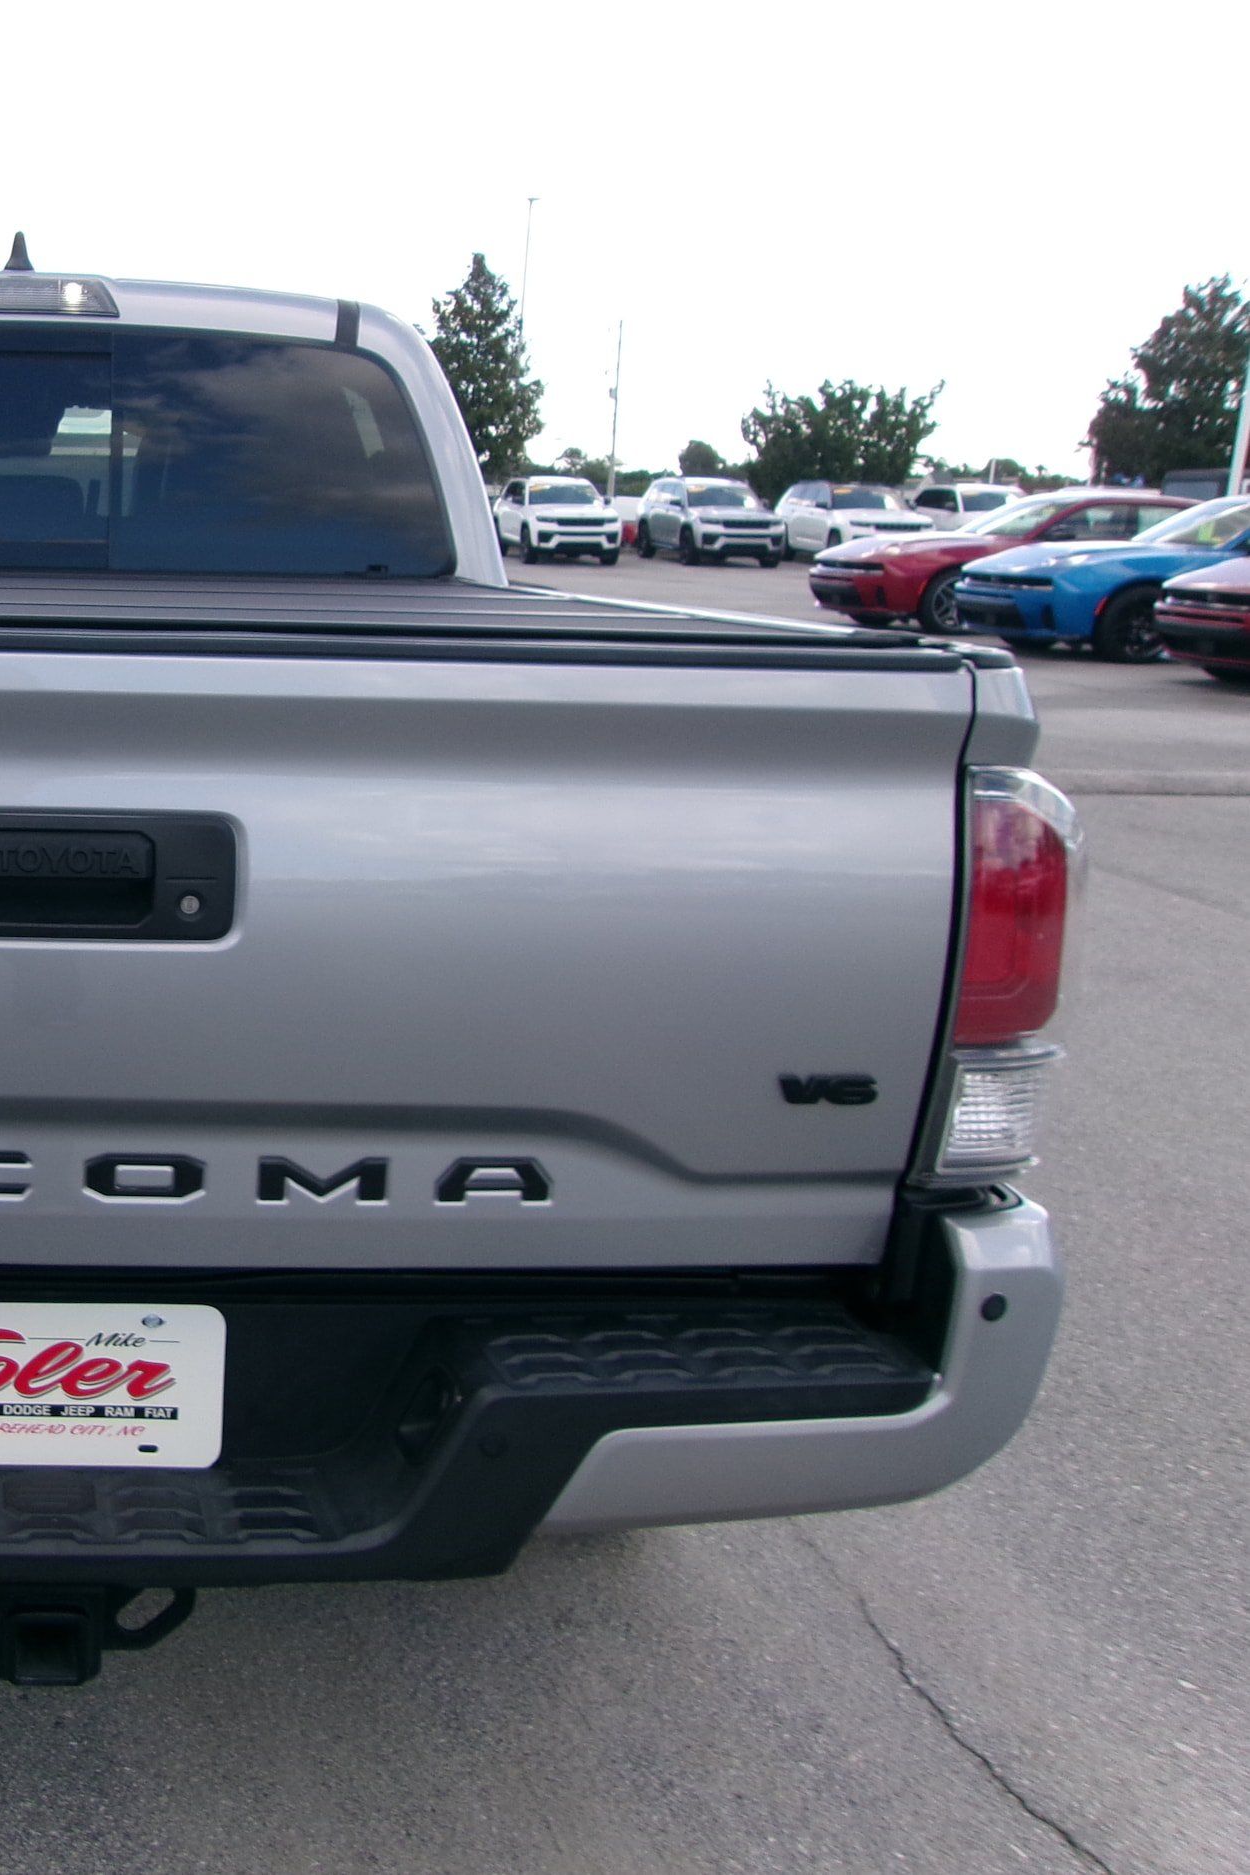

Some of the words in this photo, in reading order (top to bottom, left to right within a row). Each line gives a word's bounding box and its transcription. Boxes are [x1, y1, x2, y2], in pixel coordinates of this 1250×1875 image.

[777, 1073, 878, 1105] V6
[85, 1332, 147, 1348] Mike
[3, 1405, 51, 1417] DODGE
[60, 1406, 96, 1418] JEEP
[104, 1407, 136, 1419] RAM
[144, 1408, 175, 1420] FIAT
[118, 1425, 146, 1438] NC
